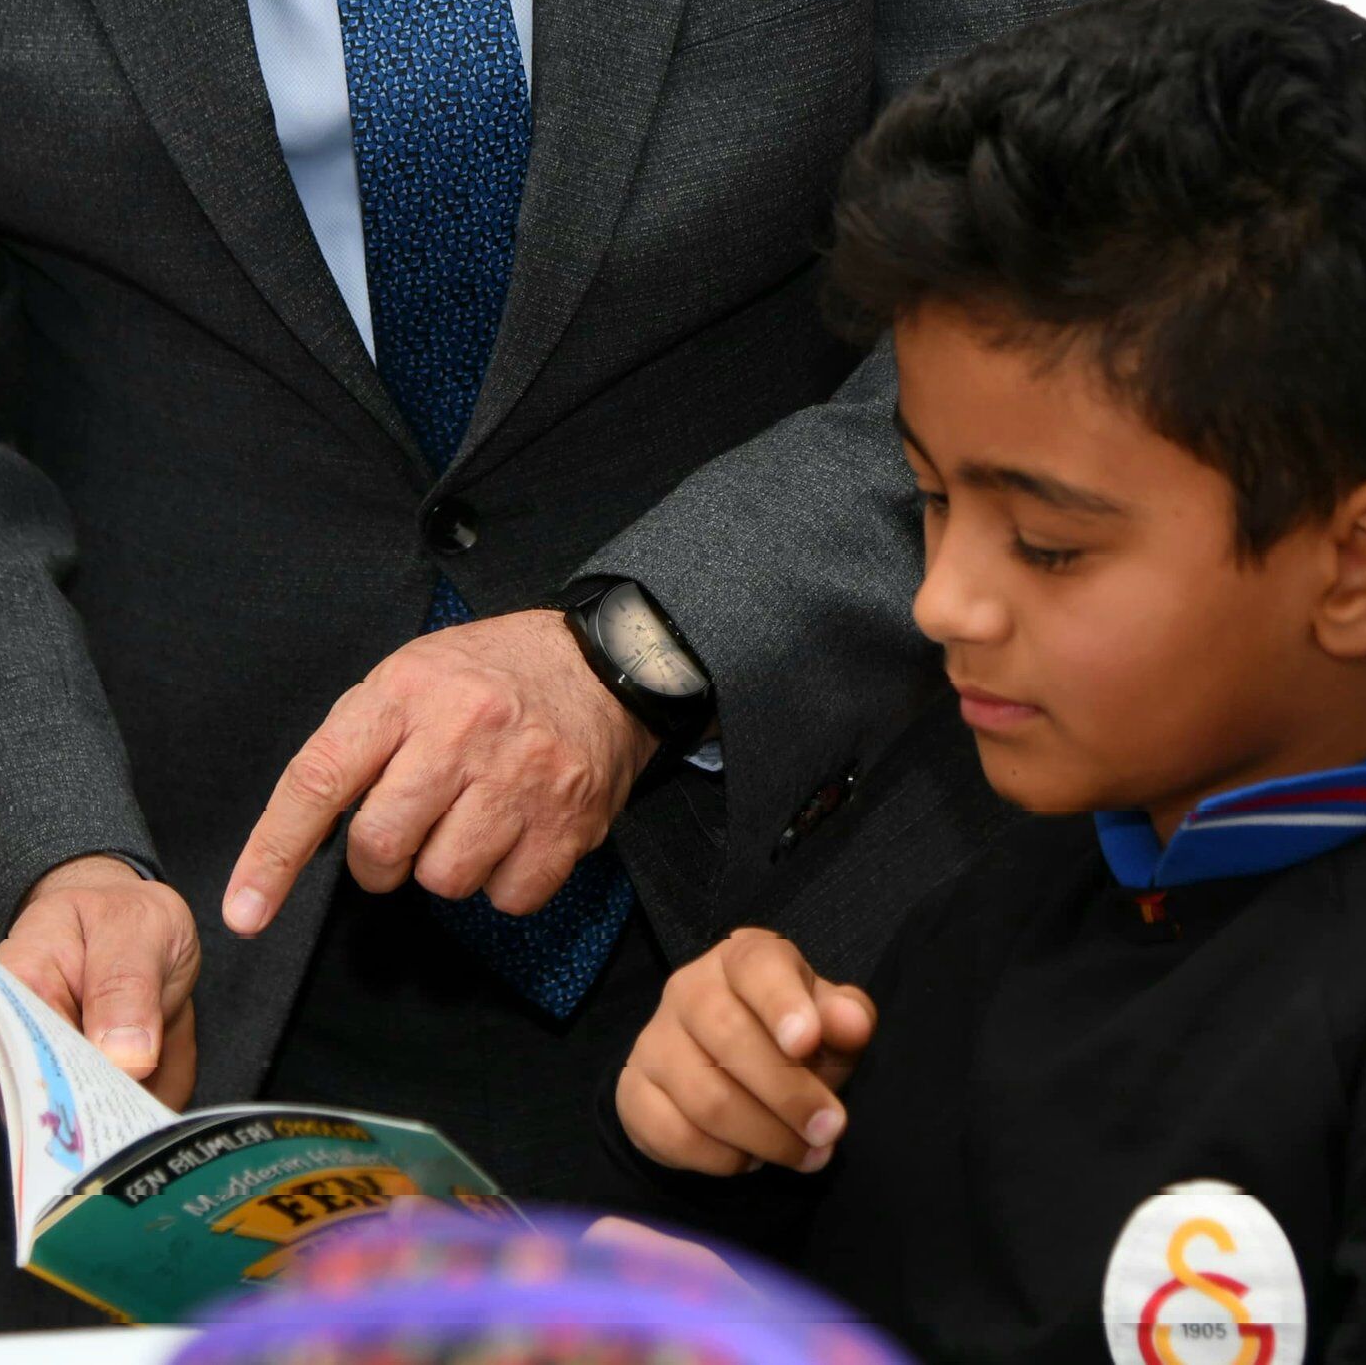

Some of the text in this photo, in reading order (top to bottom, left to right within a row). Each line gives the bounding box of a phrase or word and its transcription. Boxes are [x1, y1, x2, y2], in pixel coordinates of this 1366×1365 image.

[126, 1168, 168, 1203] FEN
[257, 1175, 389, 1226] FEN
[1181, 1322, 1227, 1339] 1905
